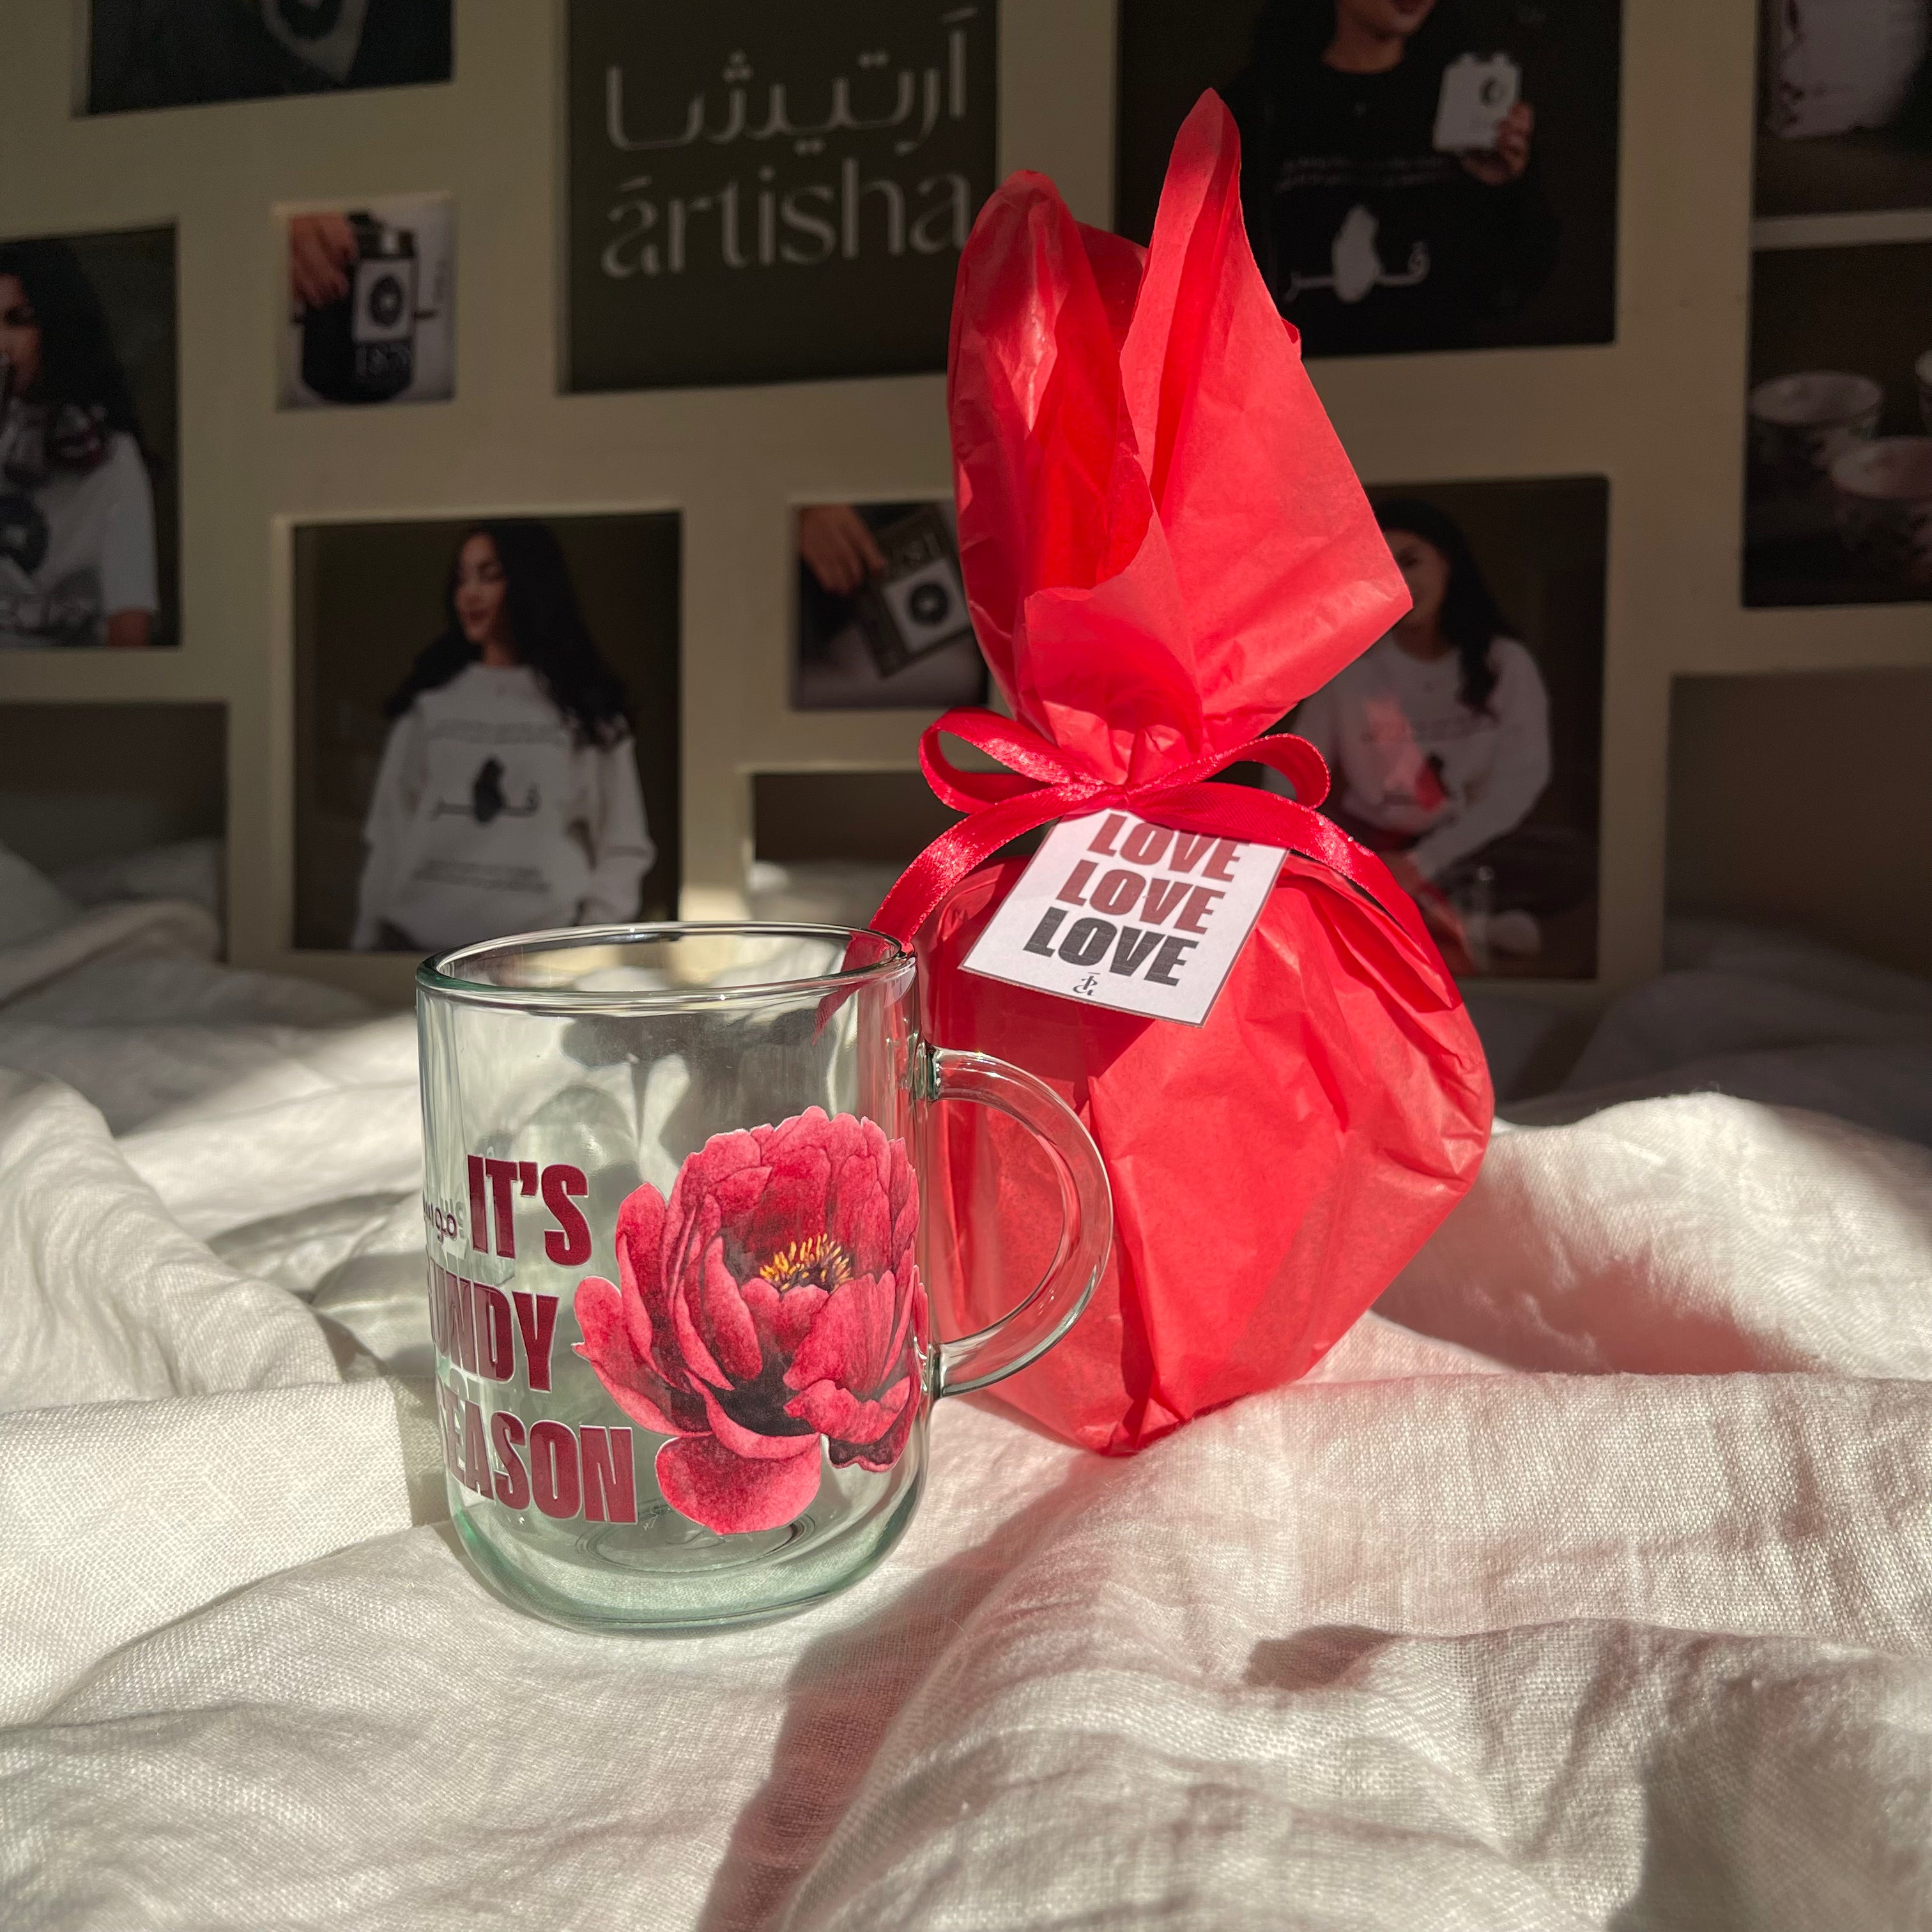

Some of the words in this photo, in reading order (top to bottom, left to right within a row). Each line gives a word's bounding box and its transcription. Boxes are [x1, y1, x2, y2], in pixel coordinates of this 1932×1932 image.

[1086, 812, 1251, 883] LOVE
[1055, 859, 1226, 935] LOVE
[1022, 906, 1199, 987] LOVE
[467, 1154, 592, 1267] IT'S
[427, 1257, 559, 1393] UNDY
